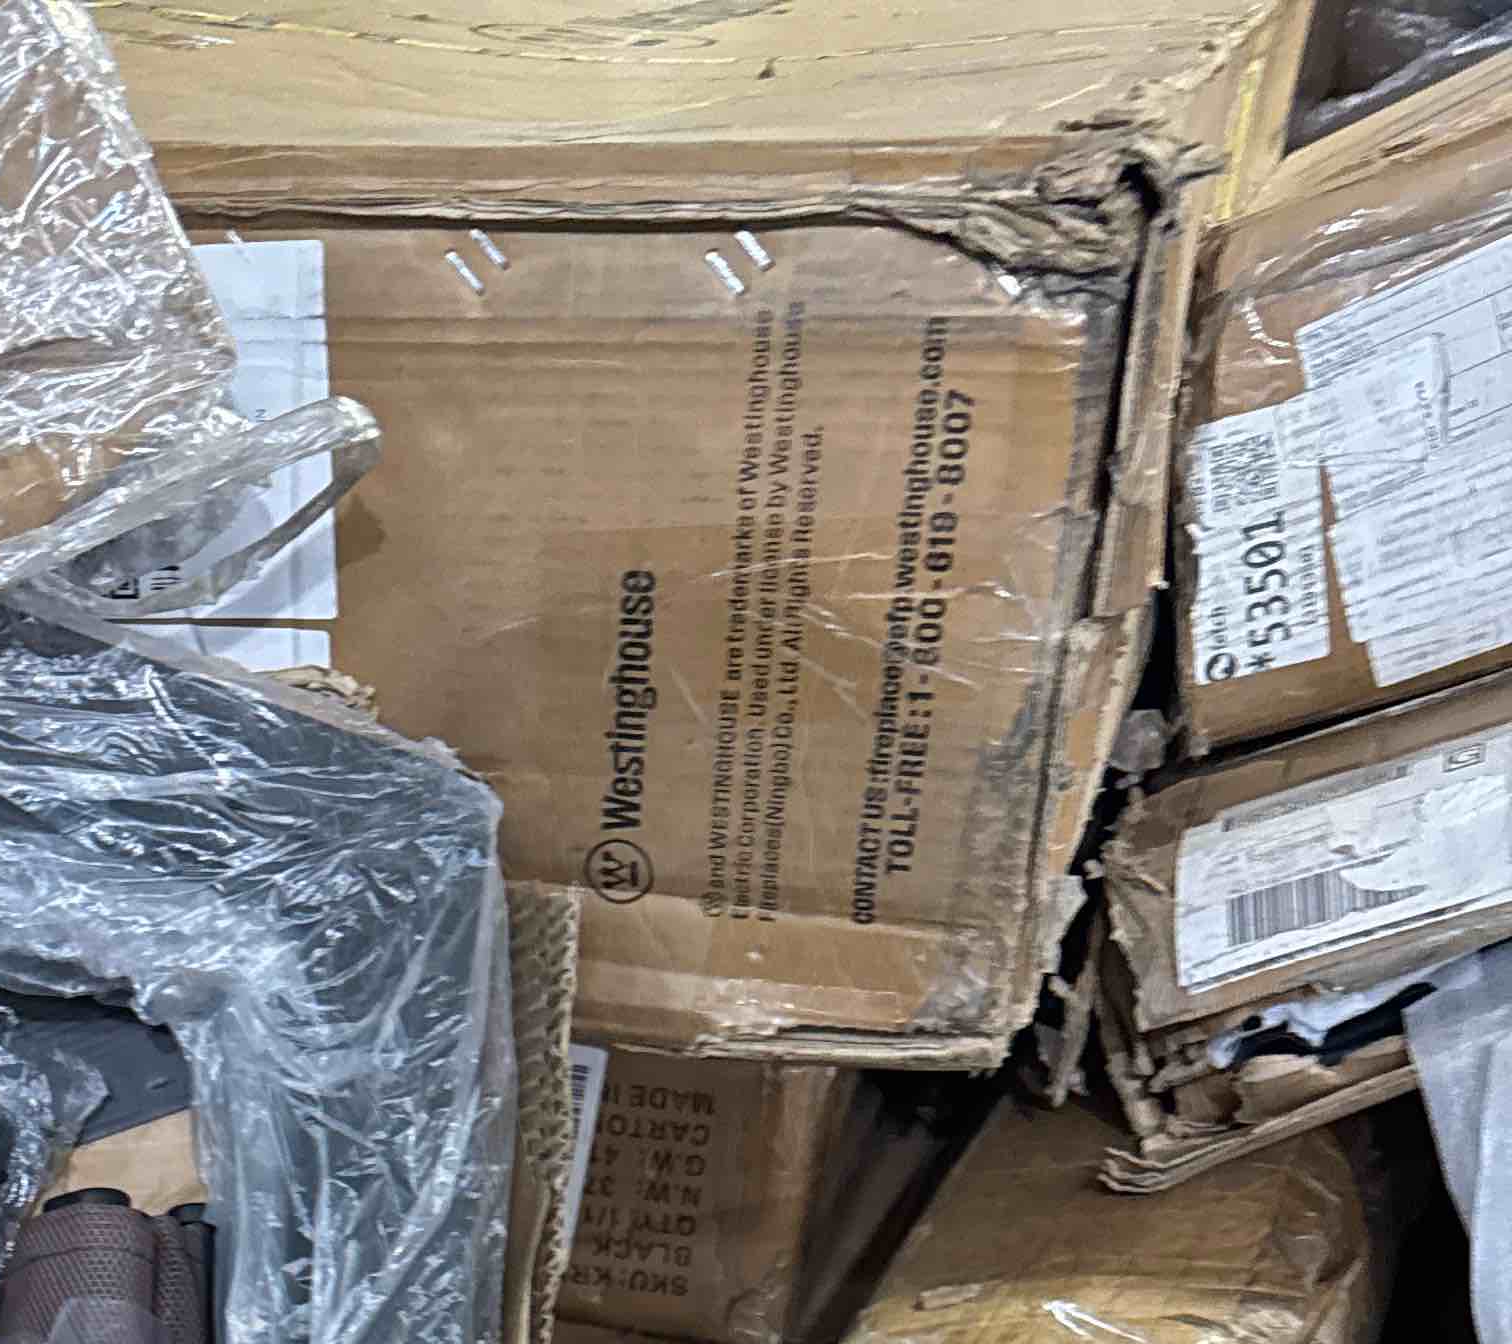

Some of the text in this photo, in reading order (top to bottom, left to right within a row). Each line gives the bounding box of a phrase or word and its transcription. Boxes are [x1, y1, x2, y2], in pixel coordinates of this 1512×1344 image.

[738, 308, 773, 481] Westinghouse
[768, 299, 804, 475] Westinghouse
[736, 485, 756, 509] of
[763, 480, 789, 507] by
[794, 424, 823, 542] Reserved.
[752, 597, 776, 658] under
[600, 569, 656, 829] Westinghouse
[746, 662, 770, 716] Used
[708, 687, 741, 848] WESTINGHOUSE
[706, 853, 727, 887] and
[851, 821, 884, 923] CONTACT
[629, 1084, 714, 1113] MADE
[591, 1236, 690, 1265] BLACK
